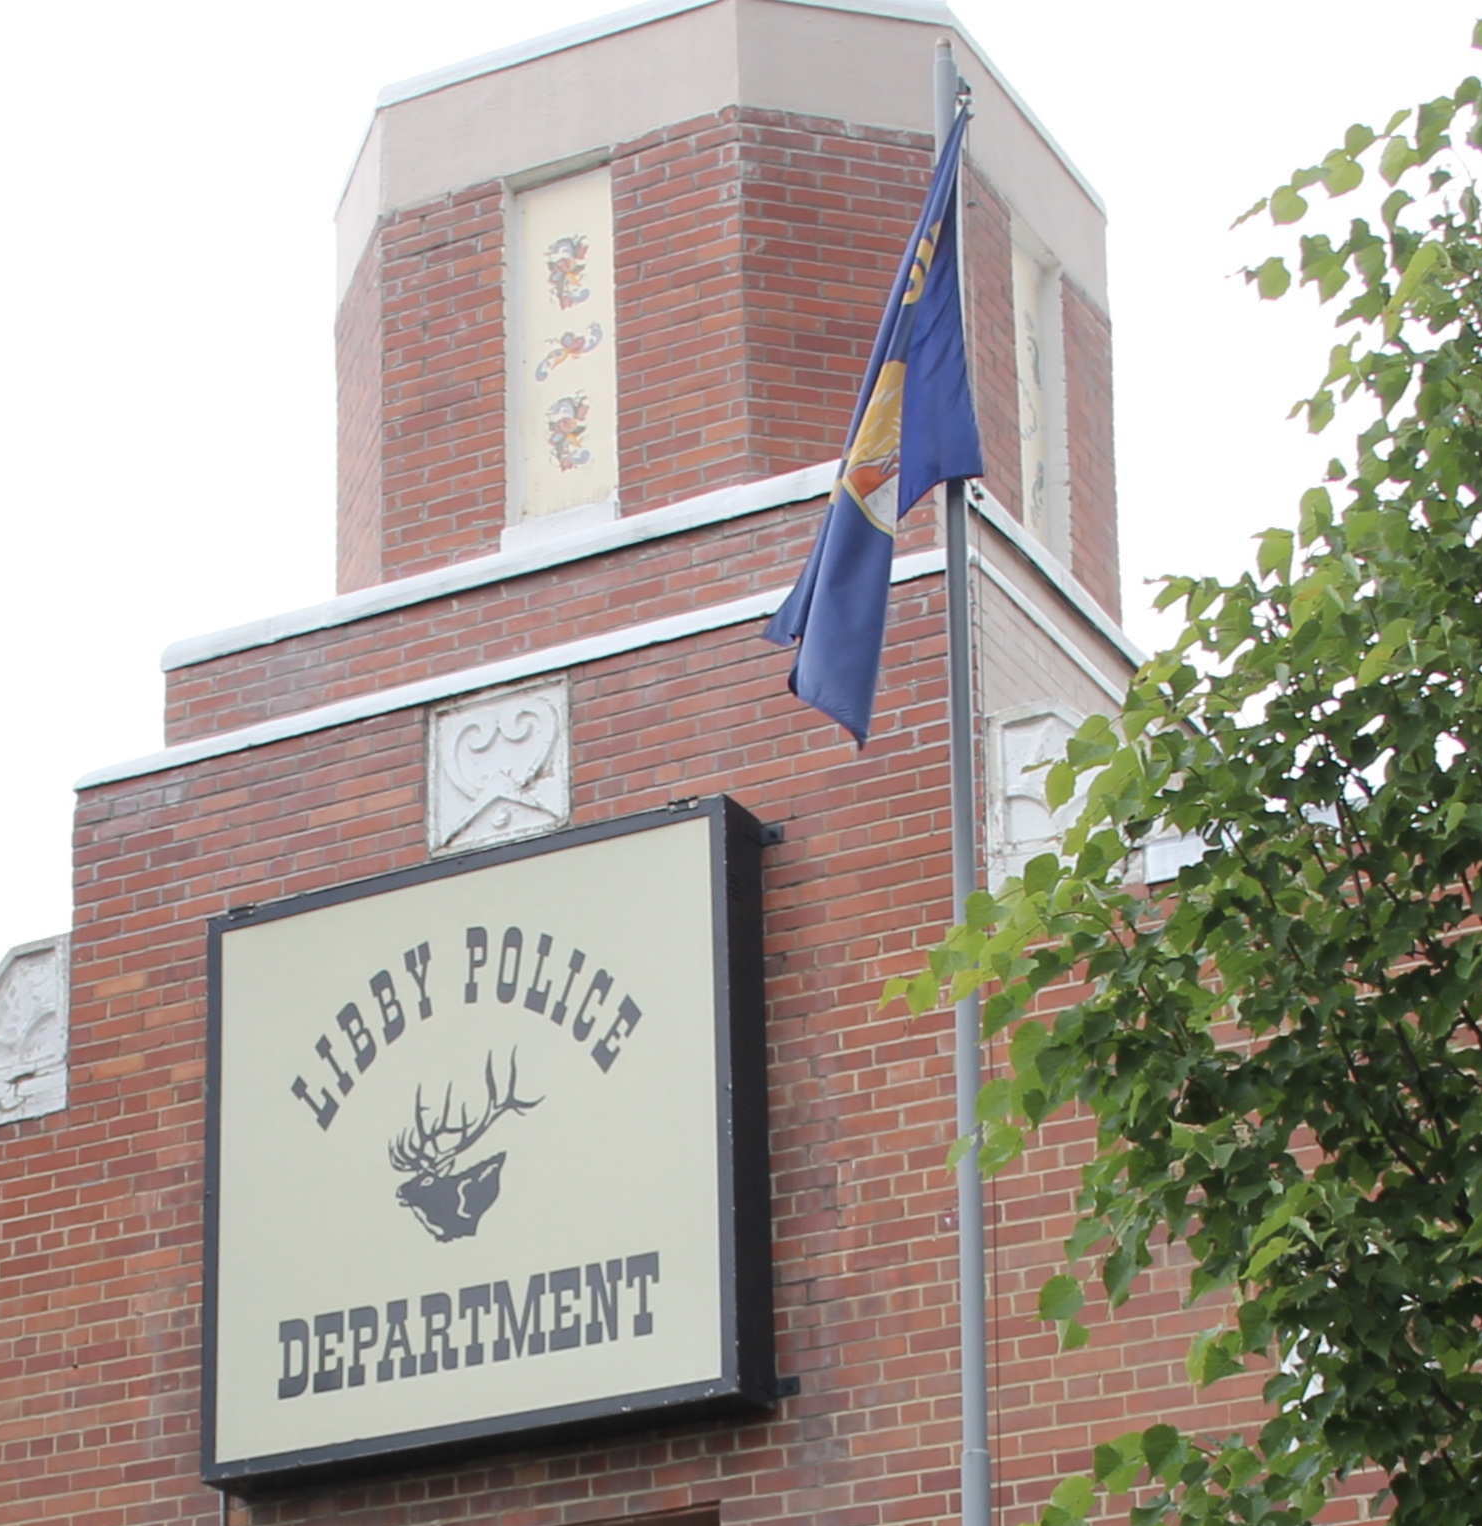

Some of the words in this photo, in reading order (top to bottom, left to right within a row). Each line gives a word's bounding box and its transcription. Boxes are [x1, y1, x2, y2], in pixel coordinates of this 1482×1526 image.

[290, 940, 433, 1132] LIBBY
[464, 926, 643, 1074] POLICE
[277, 1250, 660, 1401] DEPARTMENT
